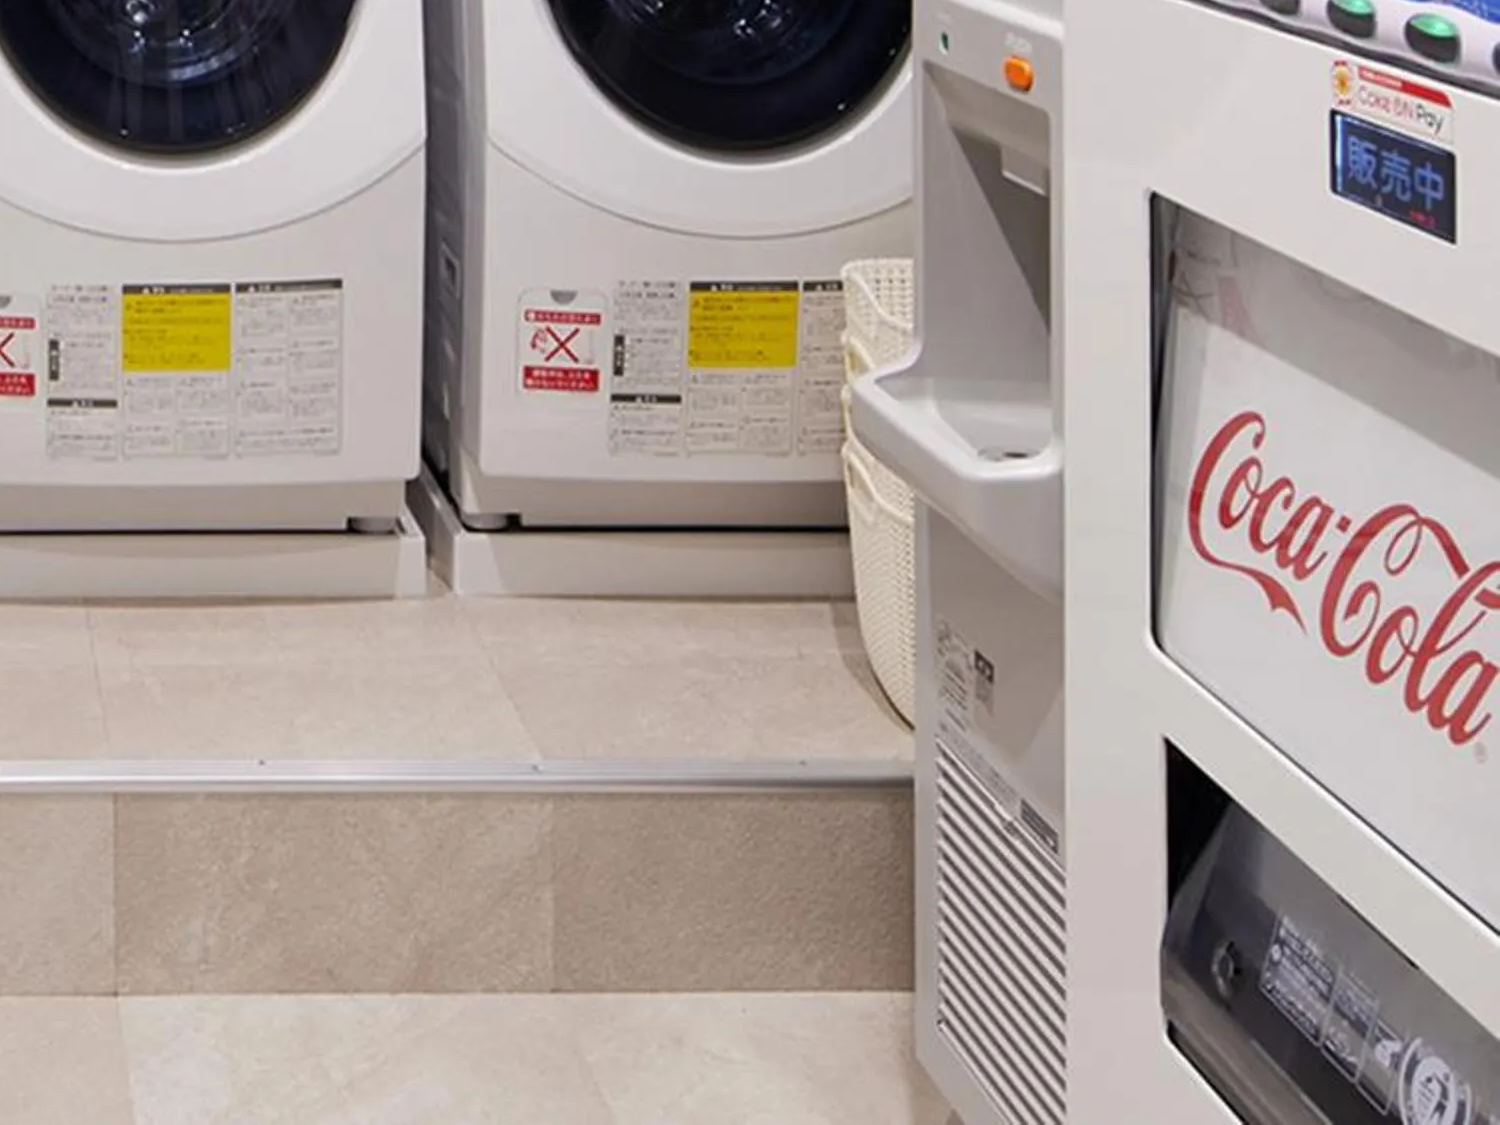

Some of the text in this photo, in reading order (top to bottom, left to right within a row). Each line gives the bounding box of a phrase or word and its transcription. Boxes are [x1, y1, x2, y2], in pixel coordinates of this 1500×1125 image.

[1415, 102, 1444, 136] Pay
[1348, 136, 1444, 210] 販売中
[1188, 410, 1500, 746] Coca-Cola
